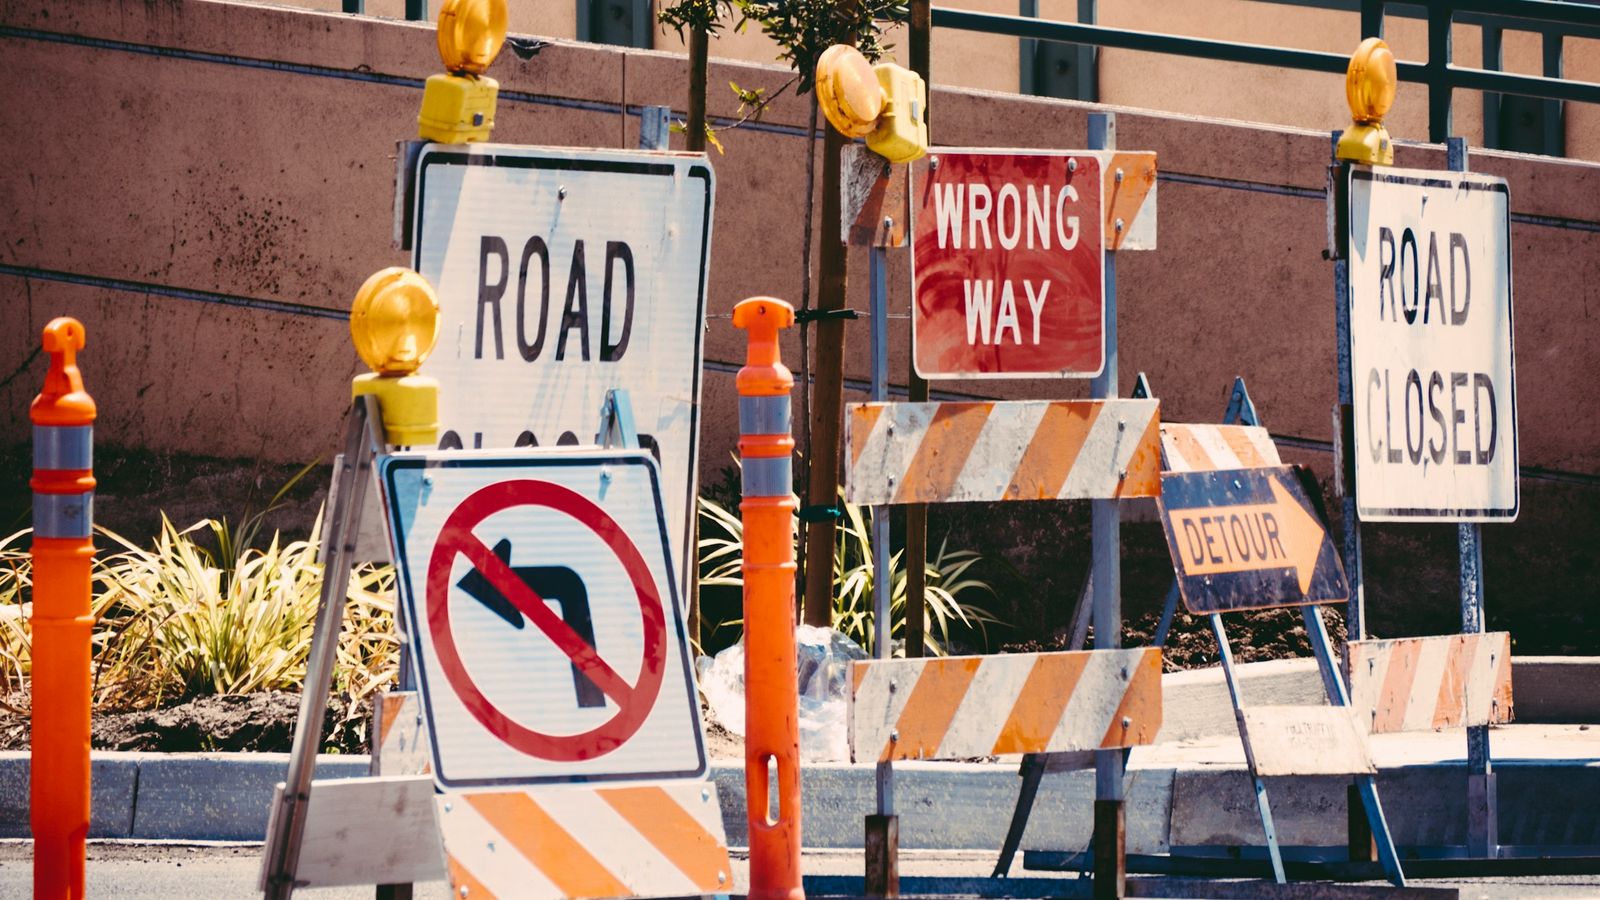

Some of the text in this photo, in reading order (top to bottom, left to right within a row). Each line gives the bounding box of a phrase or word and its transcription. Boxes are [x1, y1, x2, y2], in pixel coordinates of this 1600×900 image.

[934, 183, 1080, 250] WRONG
[475, 235, 635, 362] ROAD
[964, 280, 1051, 345] WAY
[1379, 227, 1471, 326] ROAD
[1367, 367, 1497, 465] CLOSED
[1182, 512, 1286, 566] DETOUR
